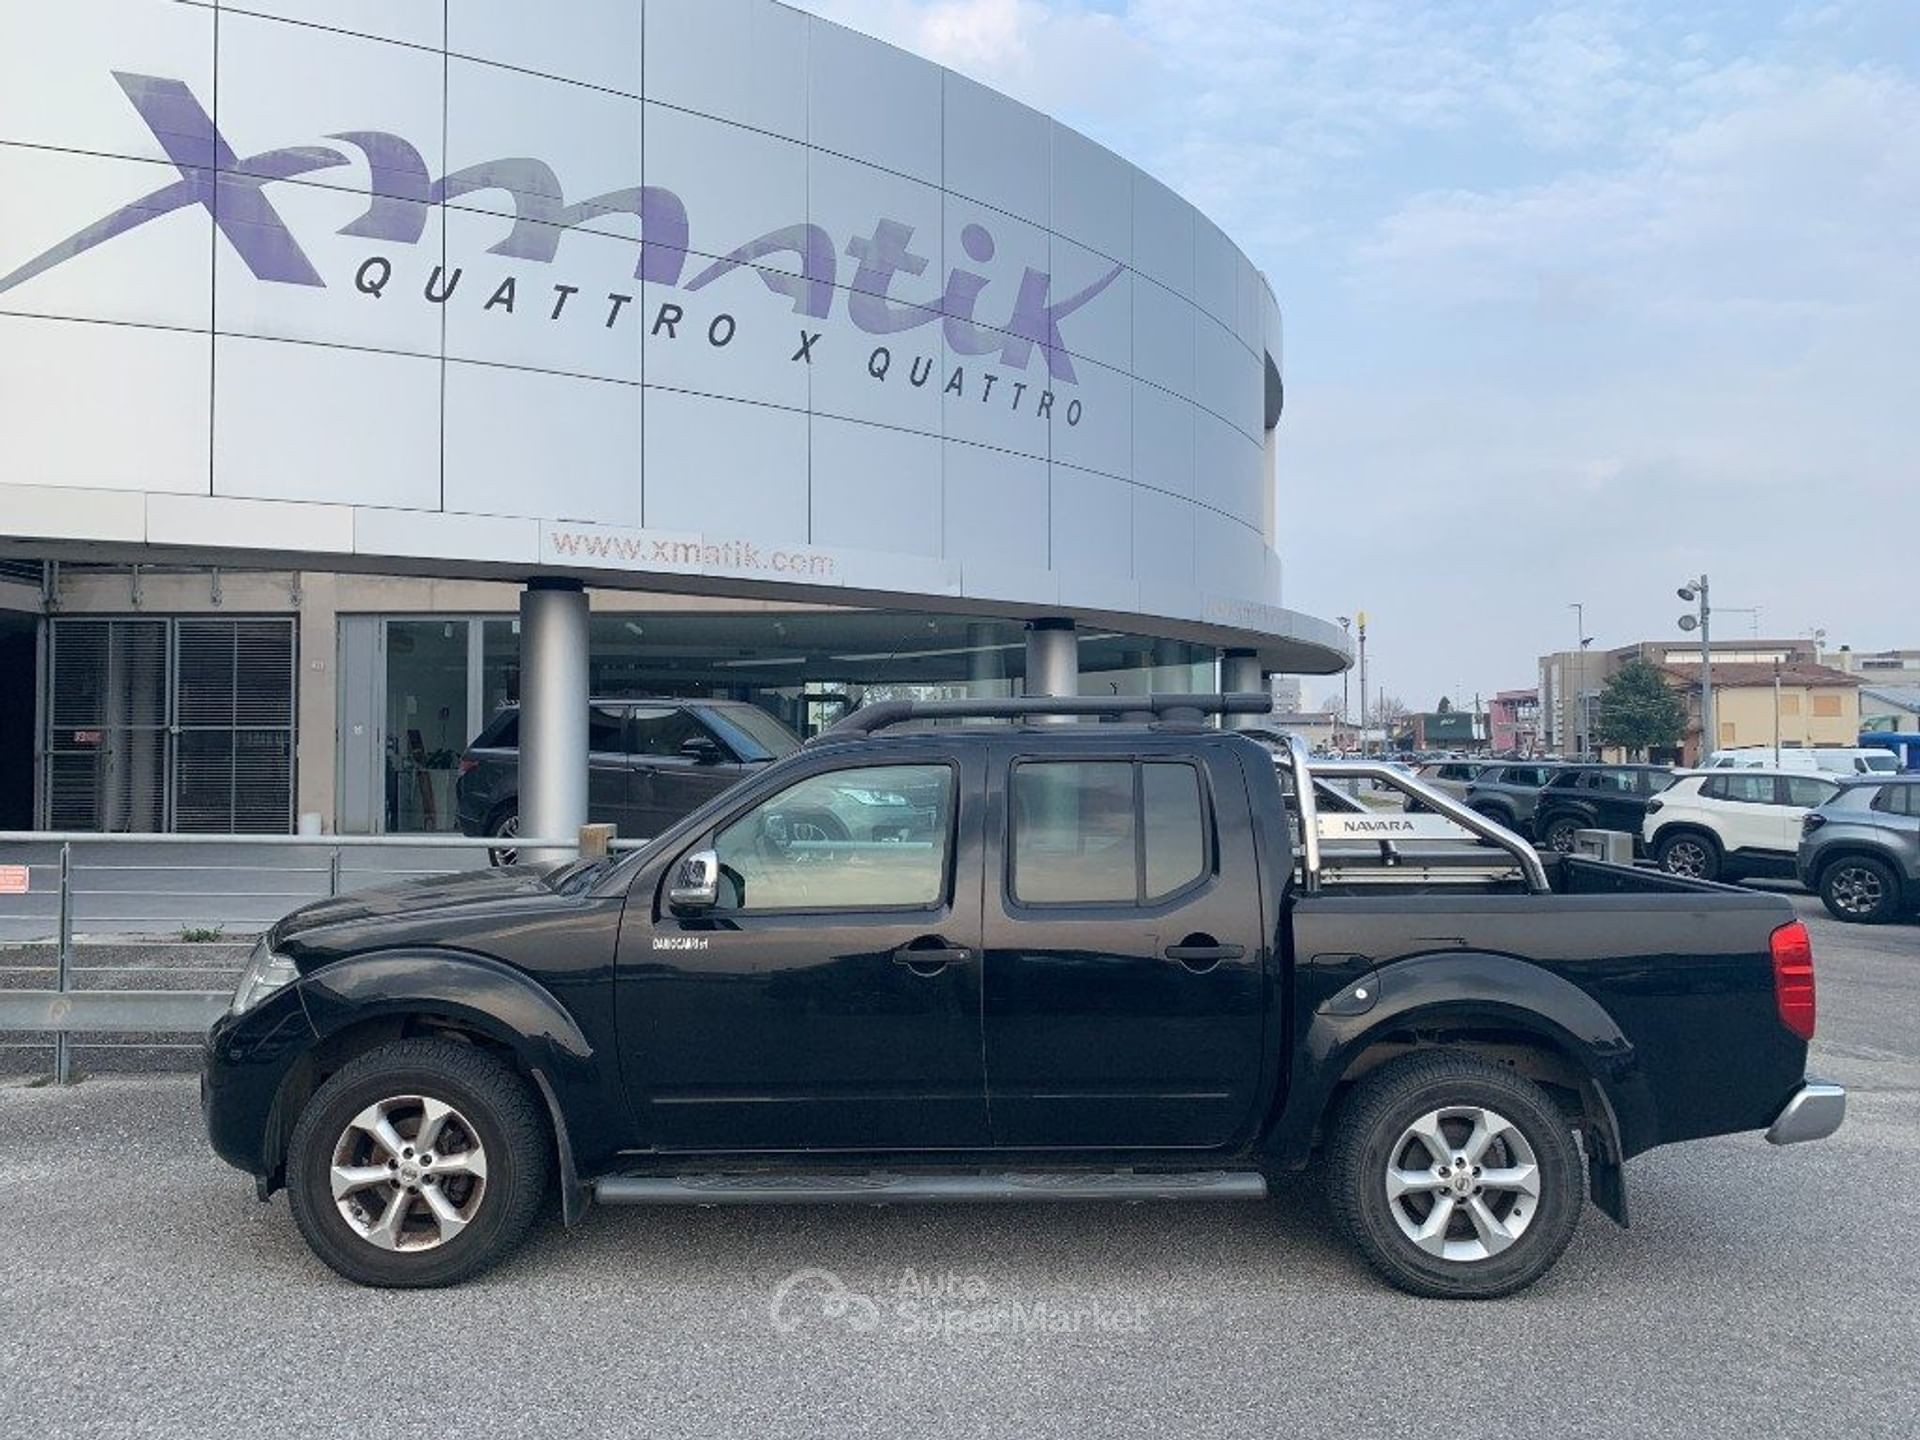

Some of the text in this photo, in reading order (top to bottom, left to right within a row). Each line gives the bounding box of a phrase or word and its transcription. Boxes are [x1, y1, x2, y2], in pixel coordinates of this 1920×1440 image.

[354, 256, 1083, 427] QUATTRO X QUATTRO
[551, 531, 835, 577] www.xmatik.com
[1343, 820, 1415, 832] NAVARA
